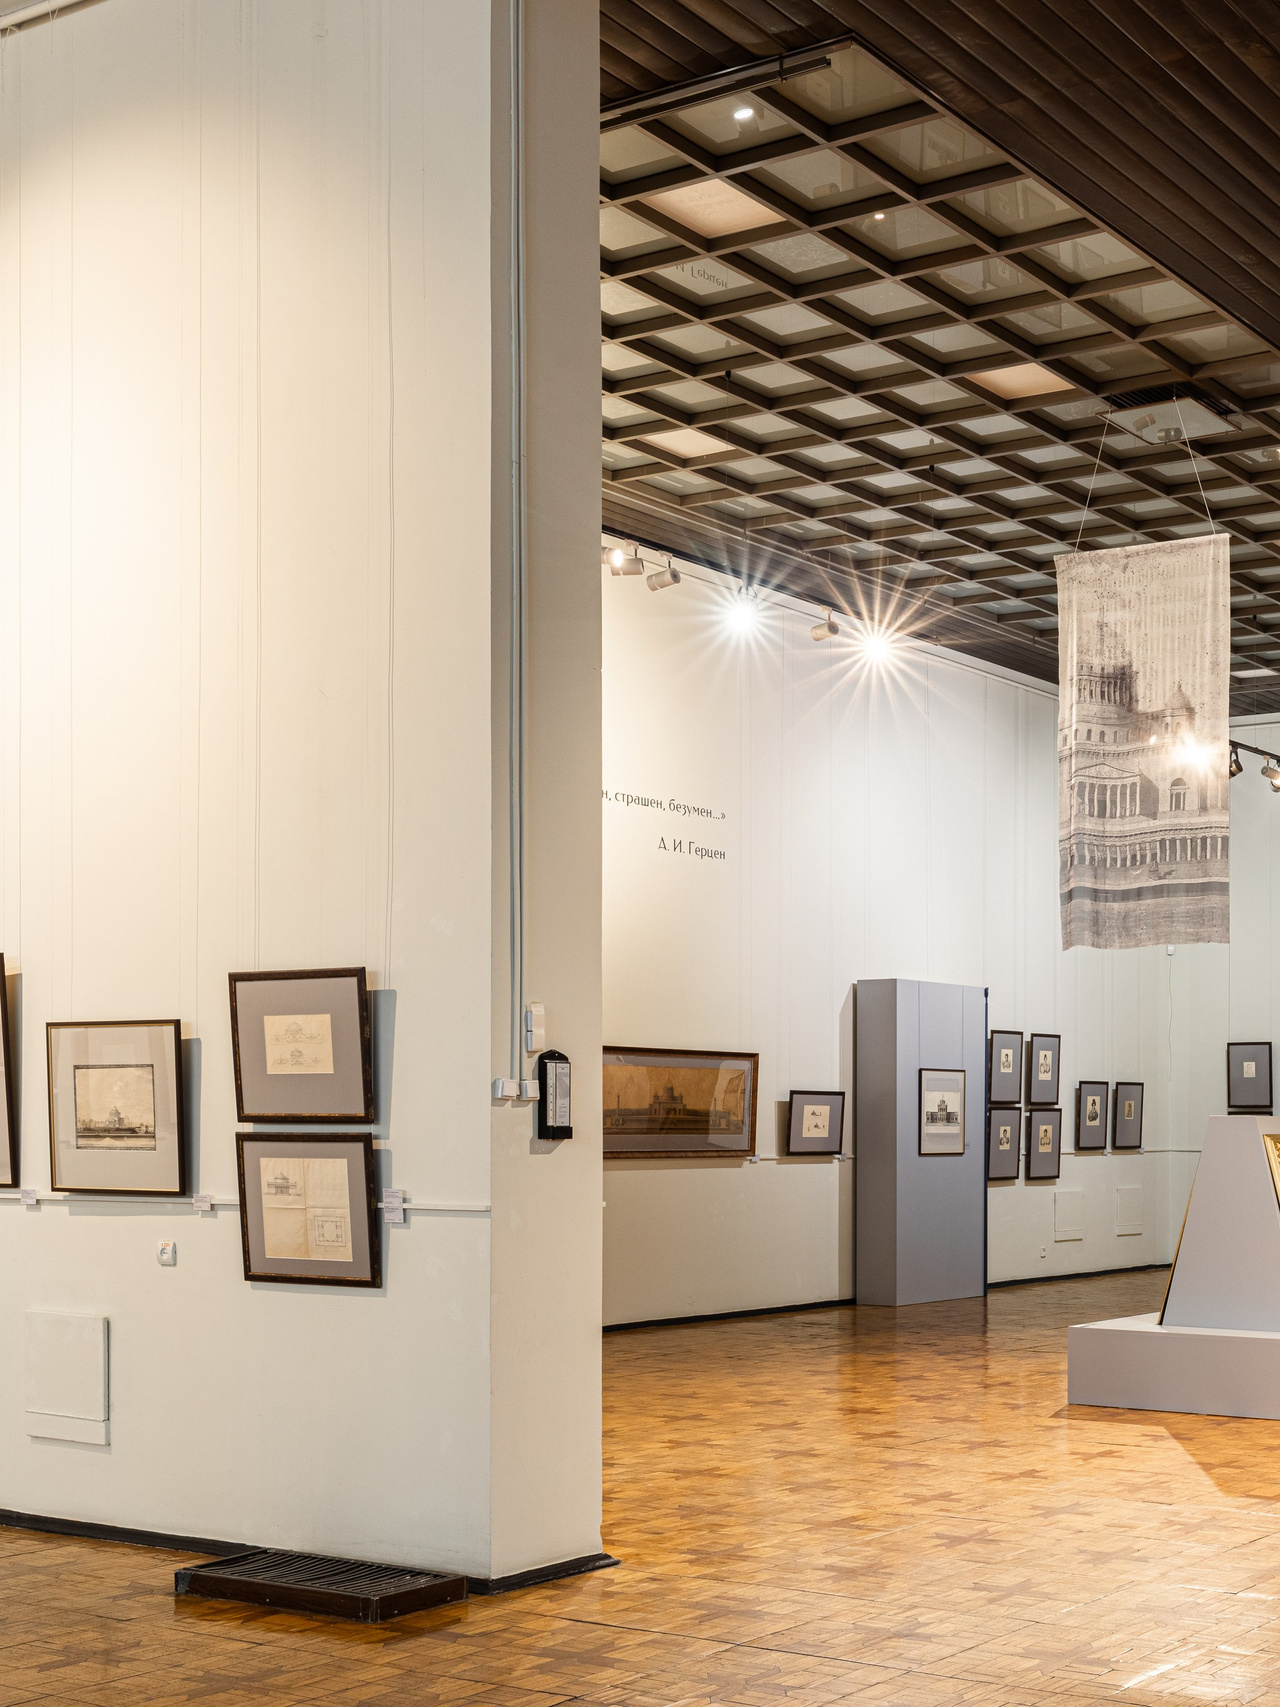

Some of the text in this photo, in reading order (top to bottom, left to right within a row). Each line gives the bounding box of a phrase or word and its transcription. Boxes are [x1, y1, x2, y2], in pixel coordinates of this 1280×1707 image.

[614, 791, 666, 811] страшен,
[673, 838, 686, 854] И.
[688, 841, 726, 860] Герцен
